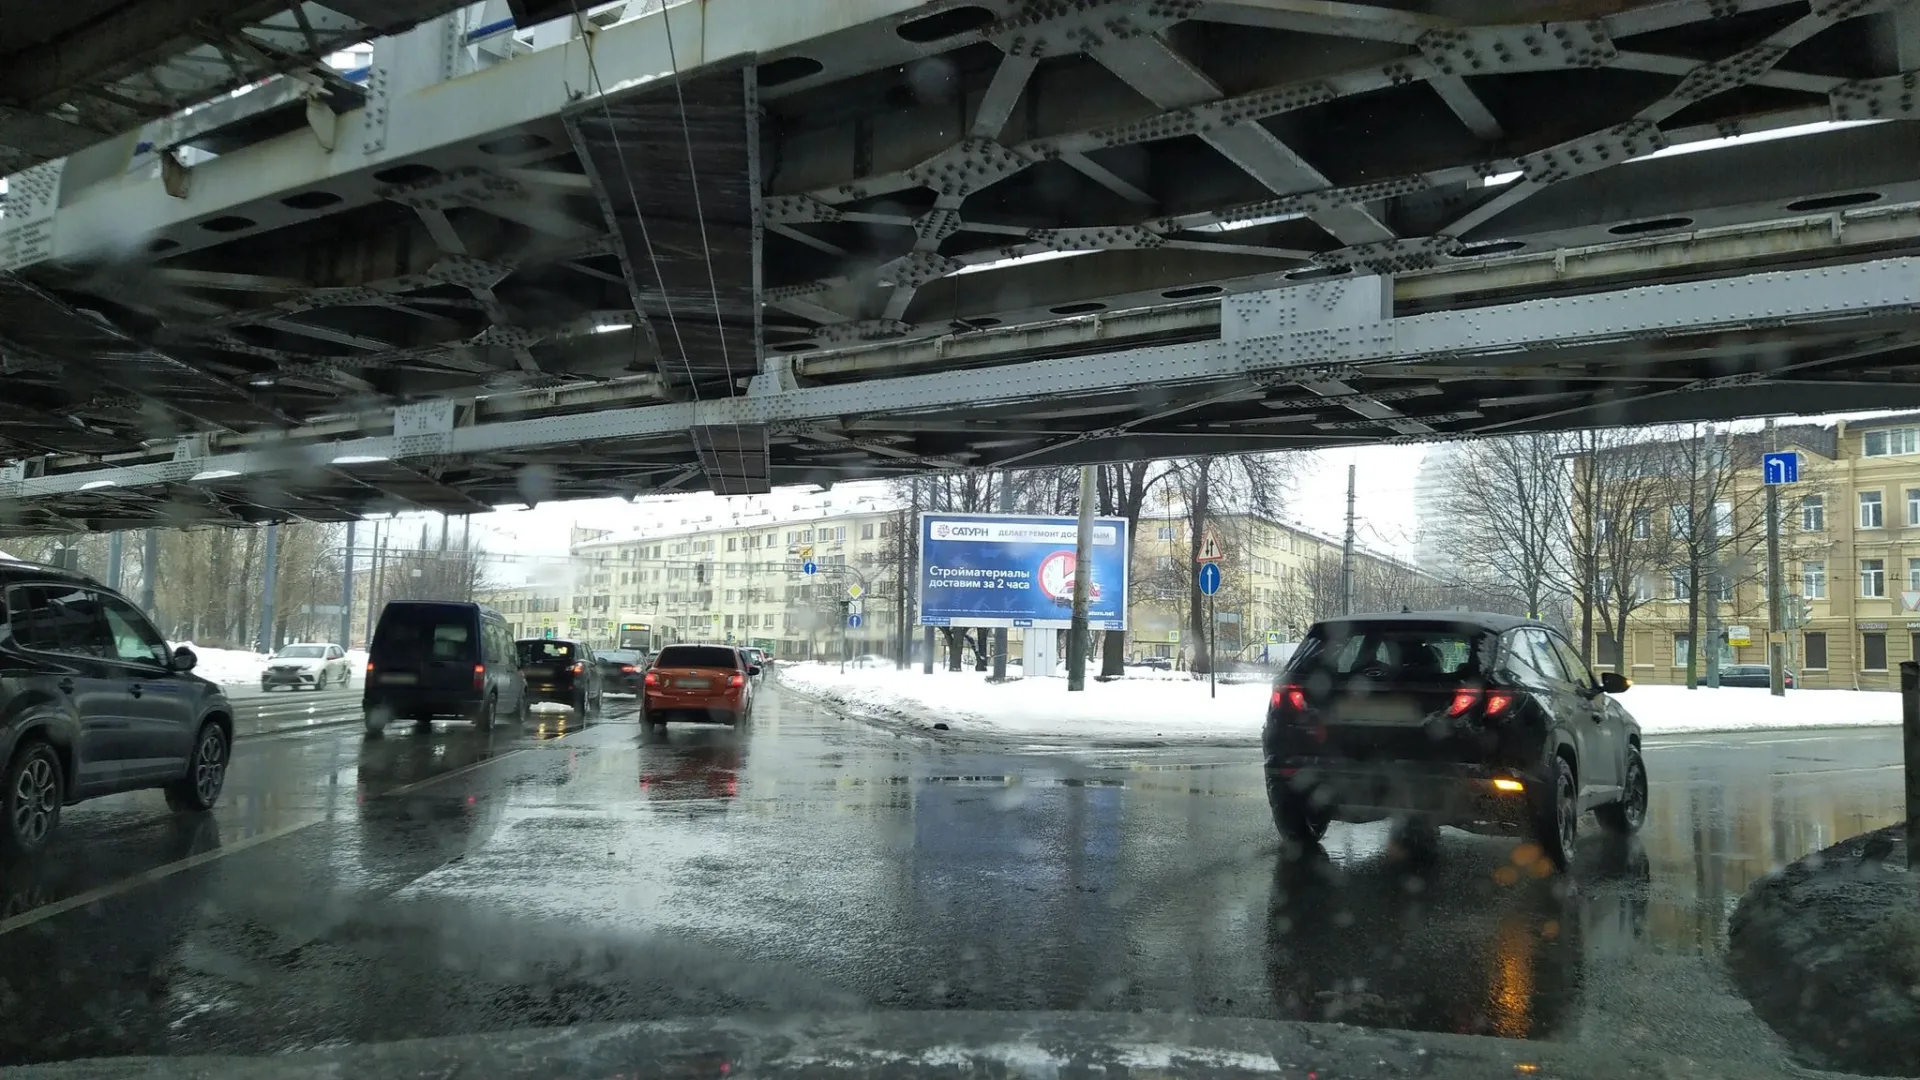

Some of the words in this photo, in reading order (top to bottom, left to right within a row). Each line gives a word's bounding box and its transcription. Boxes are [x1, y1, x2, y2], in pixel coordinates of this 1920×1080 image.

[951, 526, 989, 537] САТУРН
[998, 529, 1028, 538] ДЕЛАЕТ
[1028, 530, 1059, 539] РЕМОНТ
[929, 565, 1030, 580] Стройматериалы
[928, 579, 981, 589] доставим
[982, 581, 995, 589] за
[997, 578, 1004, 589] 2
[1006, 581, 1030, 590] часа
